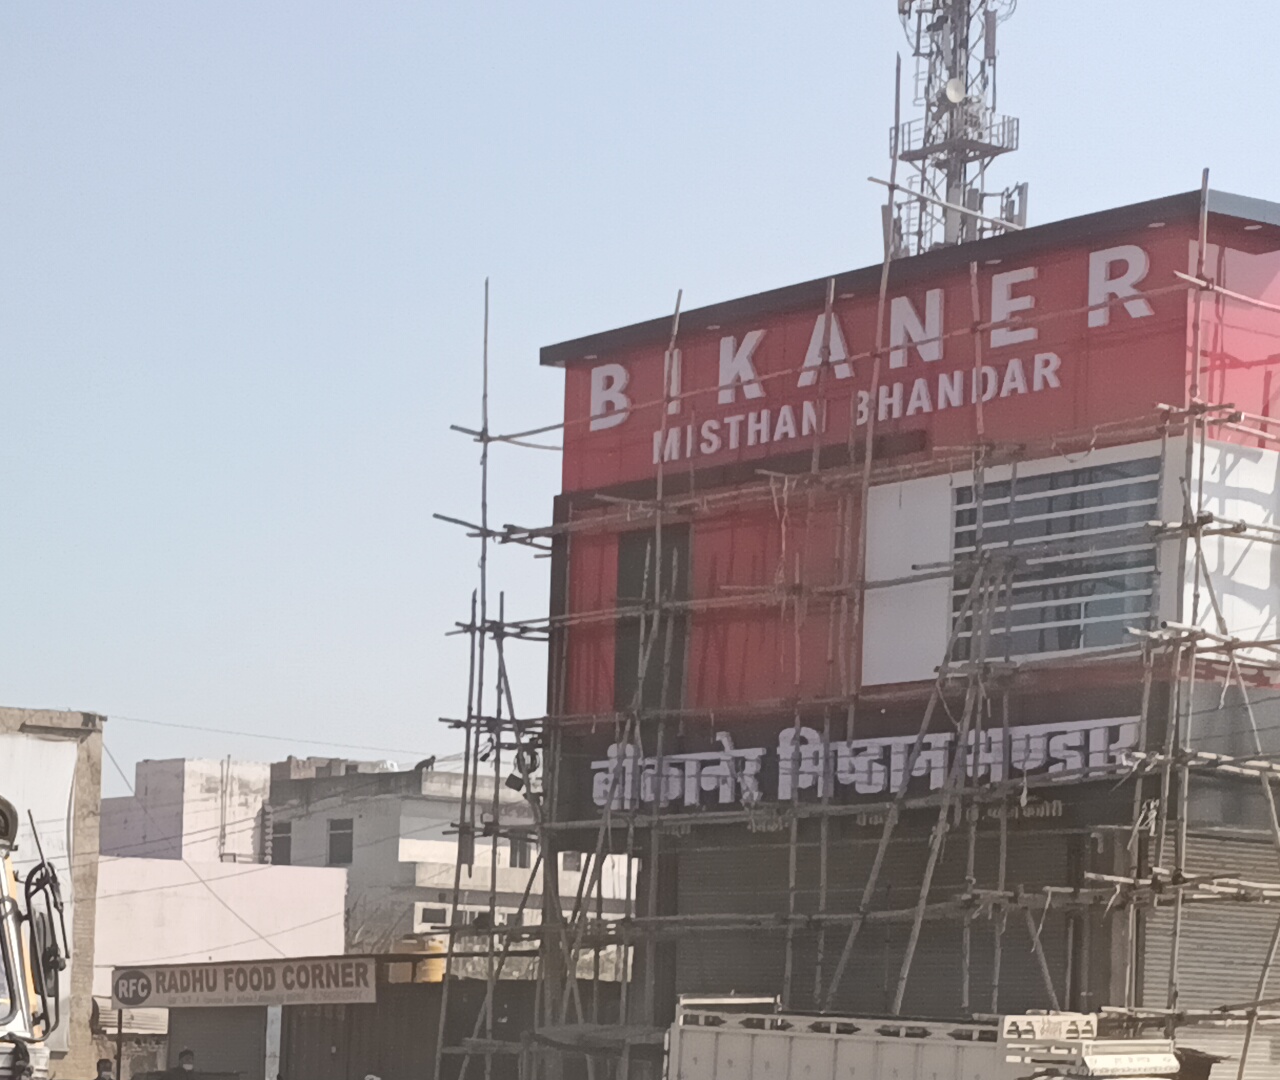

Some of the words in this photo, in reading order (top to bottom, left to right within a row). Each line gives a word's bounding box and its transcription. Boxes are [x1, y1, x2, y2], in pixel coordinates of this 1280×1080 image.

[589, 244, 1155, 431] BIKANER
[652, 399, 826, 465] MISTHAN
[856, 351, 1061, 427] BHANDAR
[118, 979, 148, 998] RFC
[155, 967, 217, 995] RADHU
[223, 966, 276, 992] FOOD
[282, 961, 370, 990] CORNER
